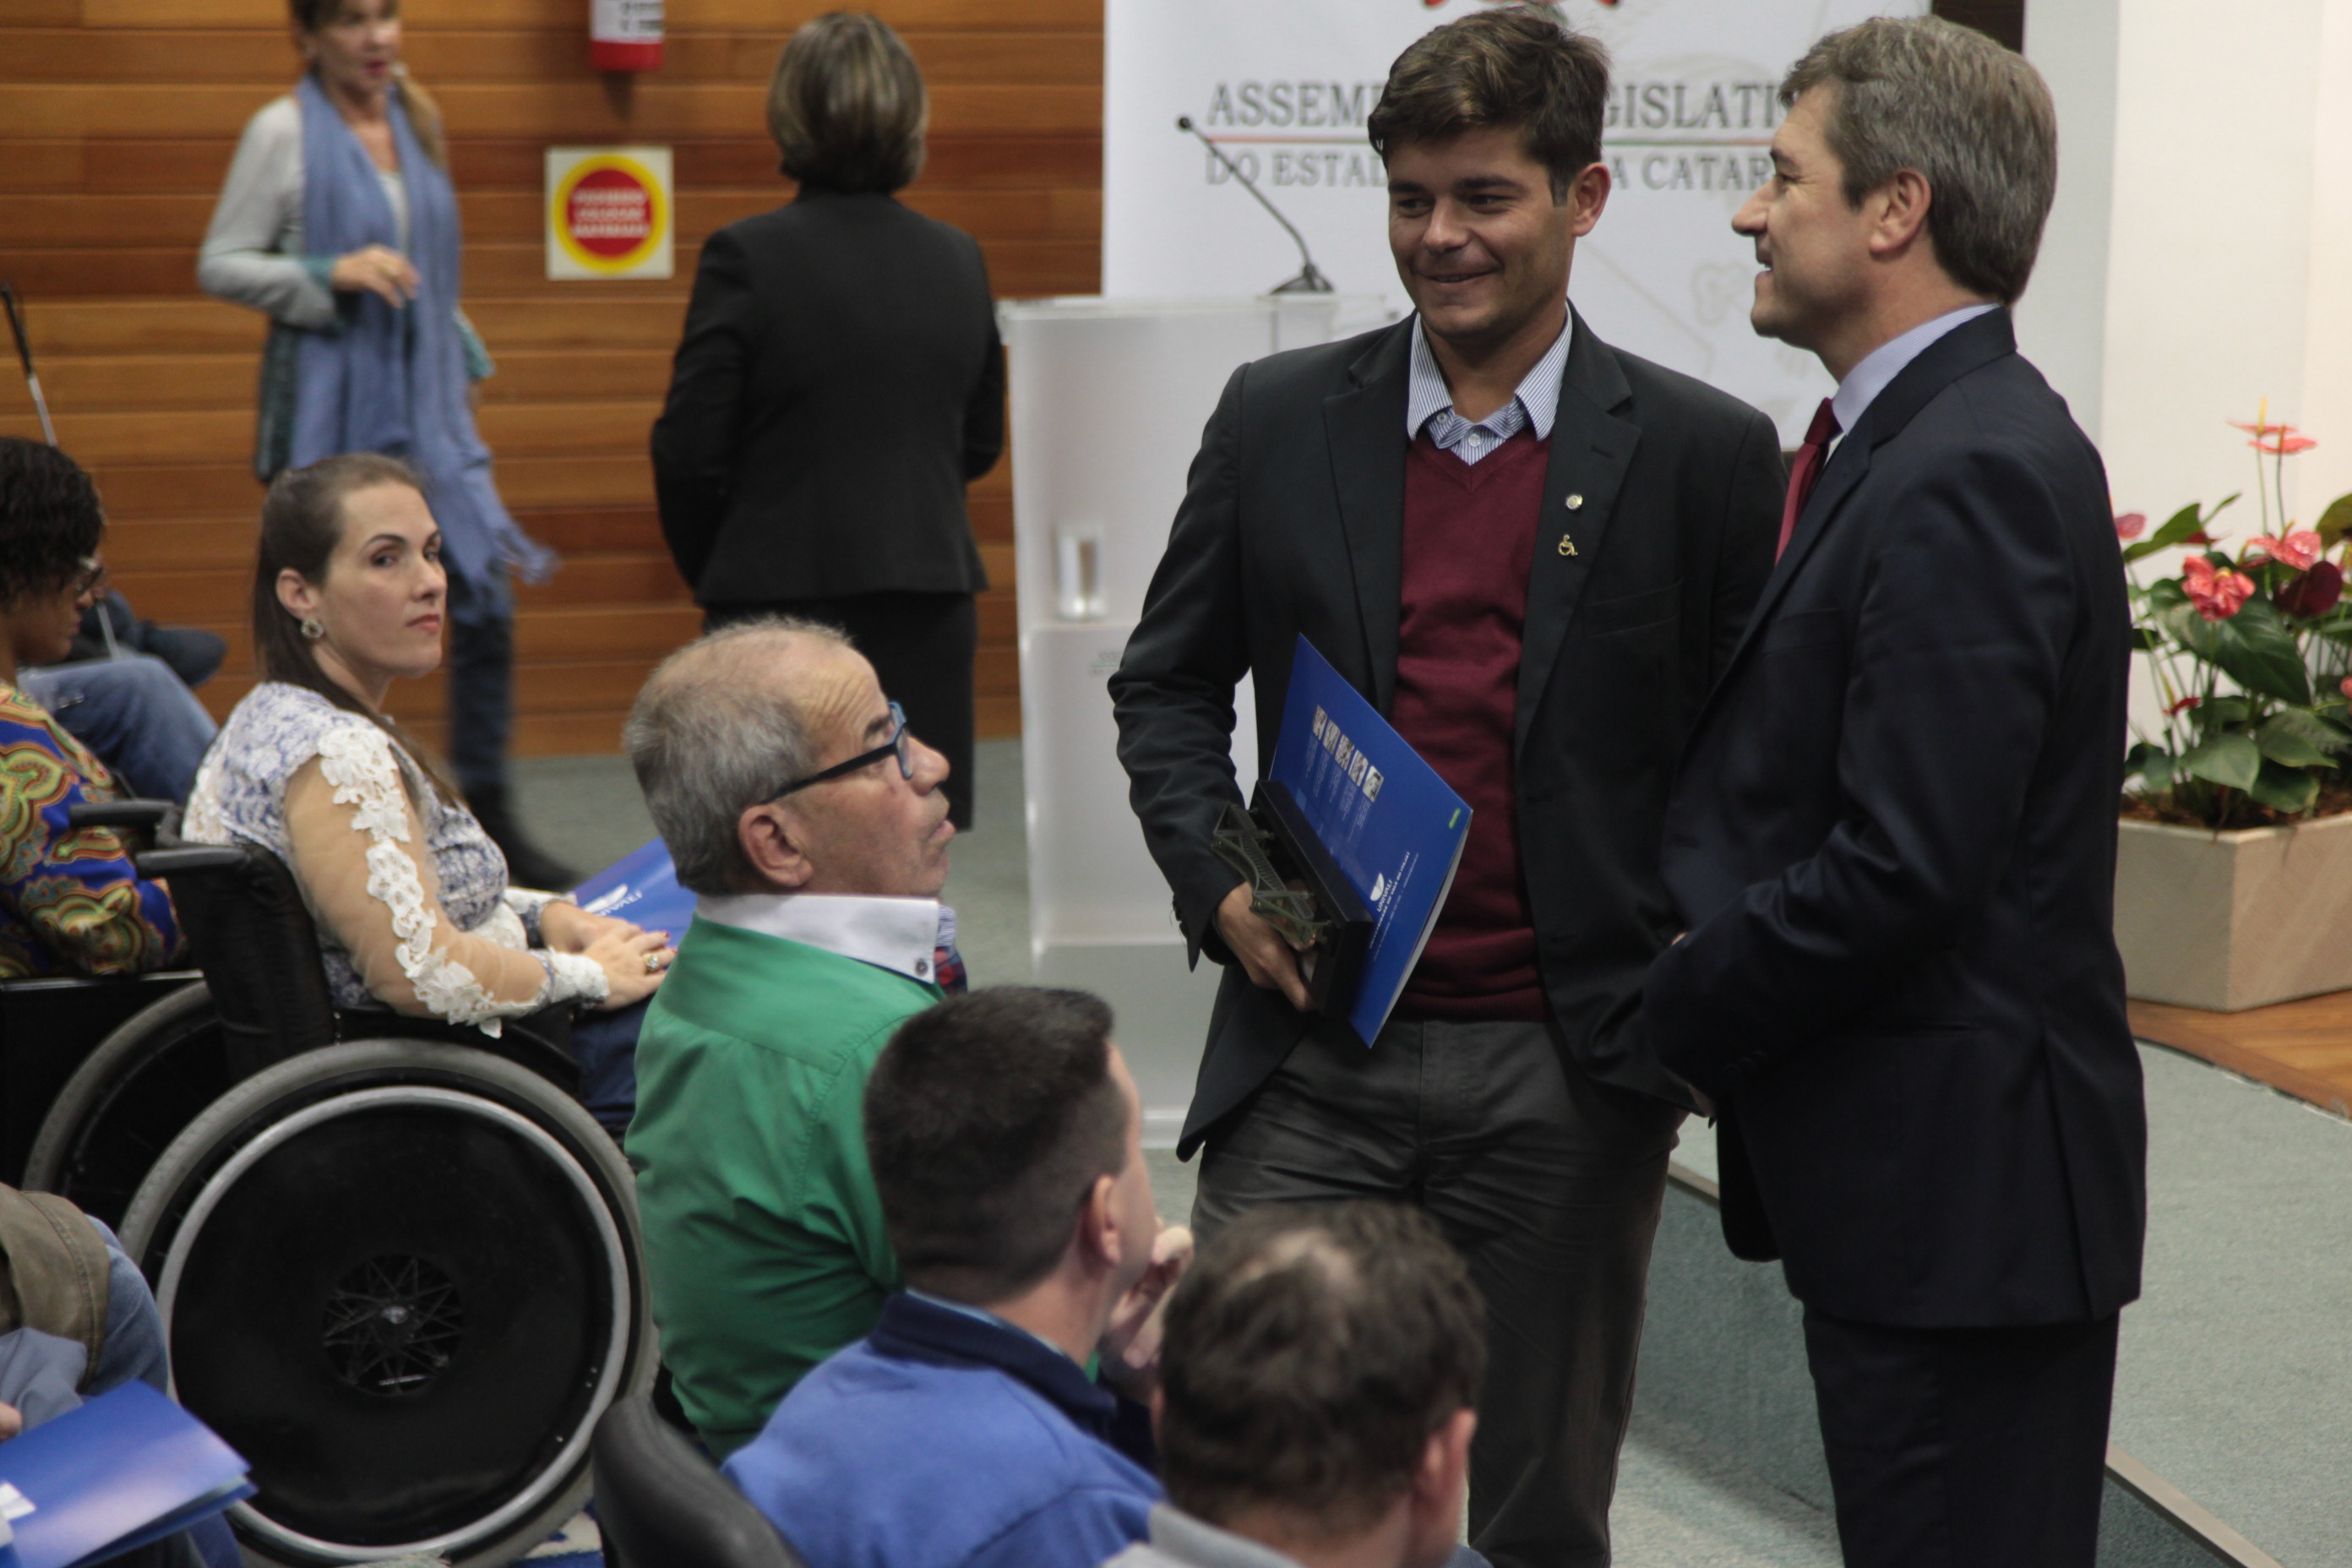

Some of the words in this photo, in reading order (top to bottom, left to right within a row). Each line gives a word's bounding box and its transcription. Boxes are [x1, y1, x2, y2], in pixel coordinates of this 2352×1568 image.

[1604, 83, 1783, 128] ISLATI
[1206, 150, 1260, 186] DO
[595, 890, 643, 917] NIVALI
[1377, 879, 1393, 912] UNIVALI
